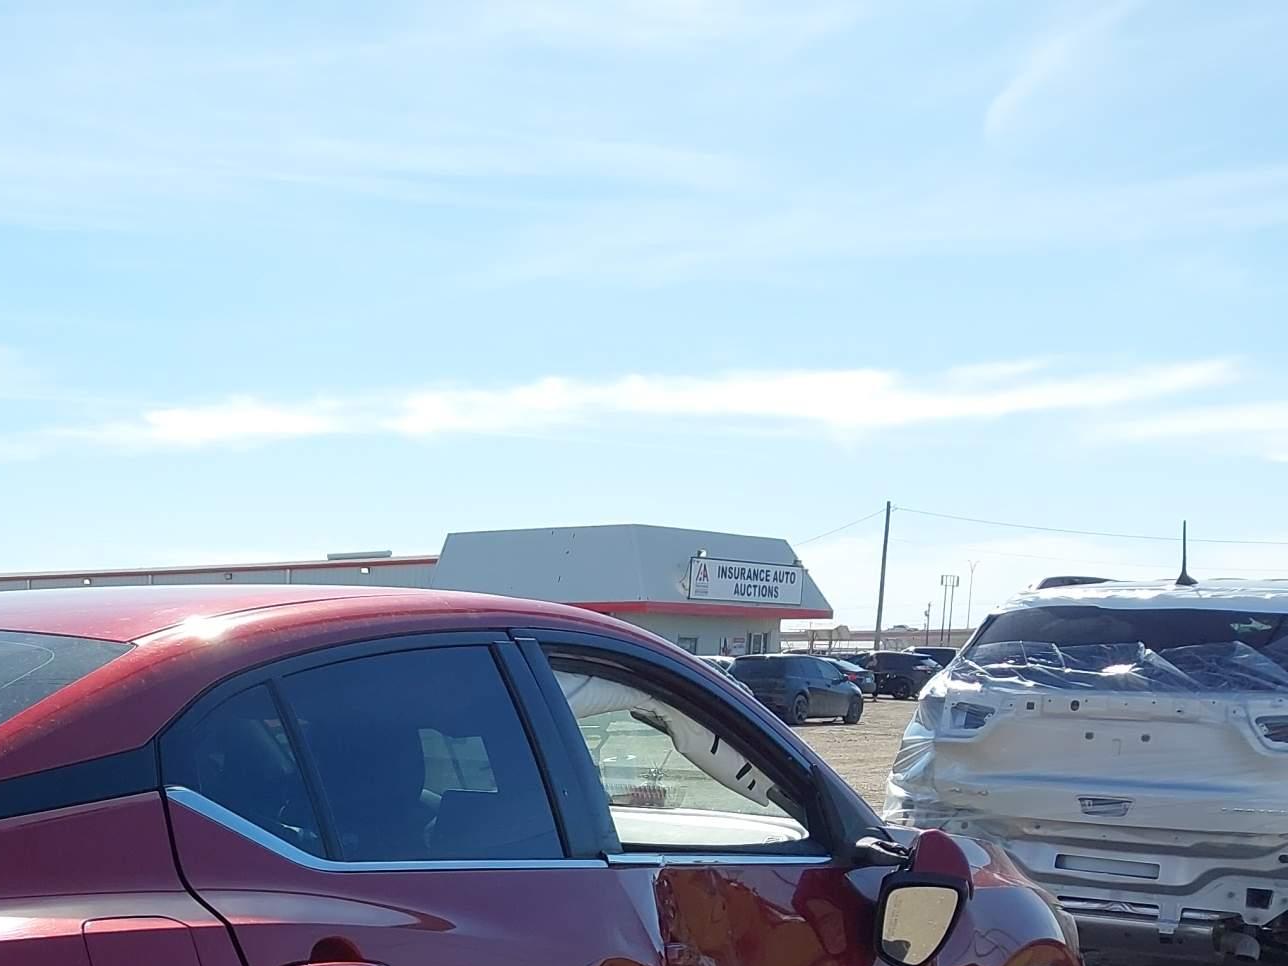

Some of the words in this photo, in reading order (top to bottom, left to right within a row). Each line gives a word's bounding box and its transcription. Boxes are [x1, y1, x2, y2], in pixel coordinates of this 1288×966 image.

[717, 565, 770, 582] INSURANCE
[773, 569, 796, 585] AUTO
[734, 583, 779, 599] AUCTIONS
